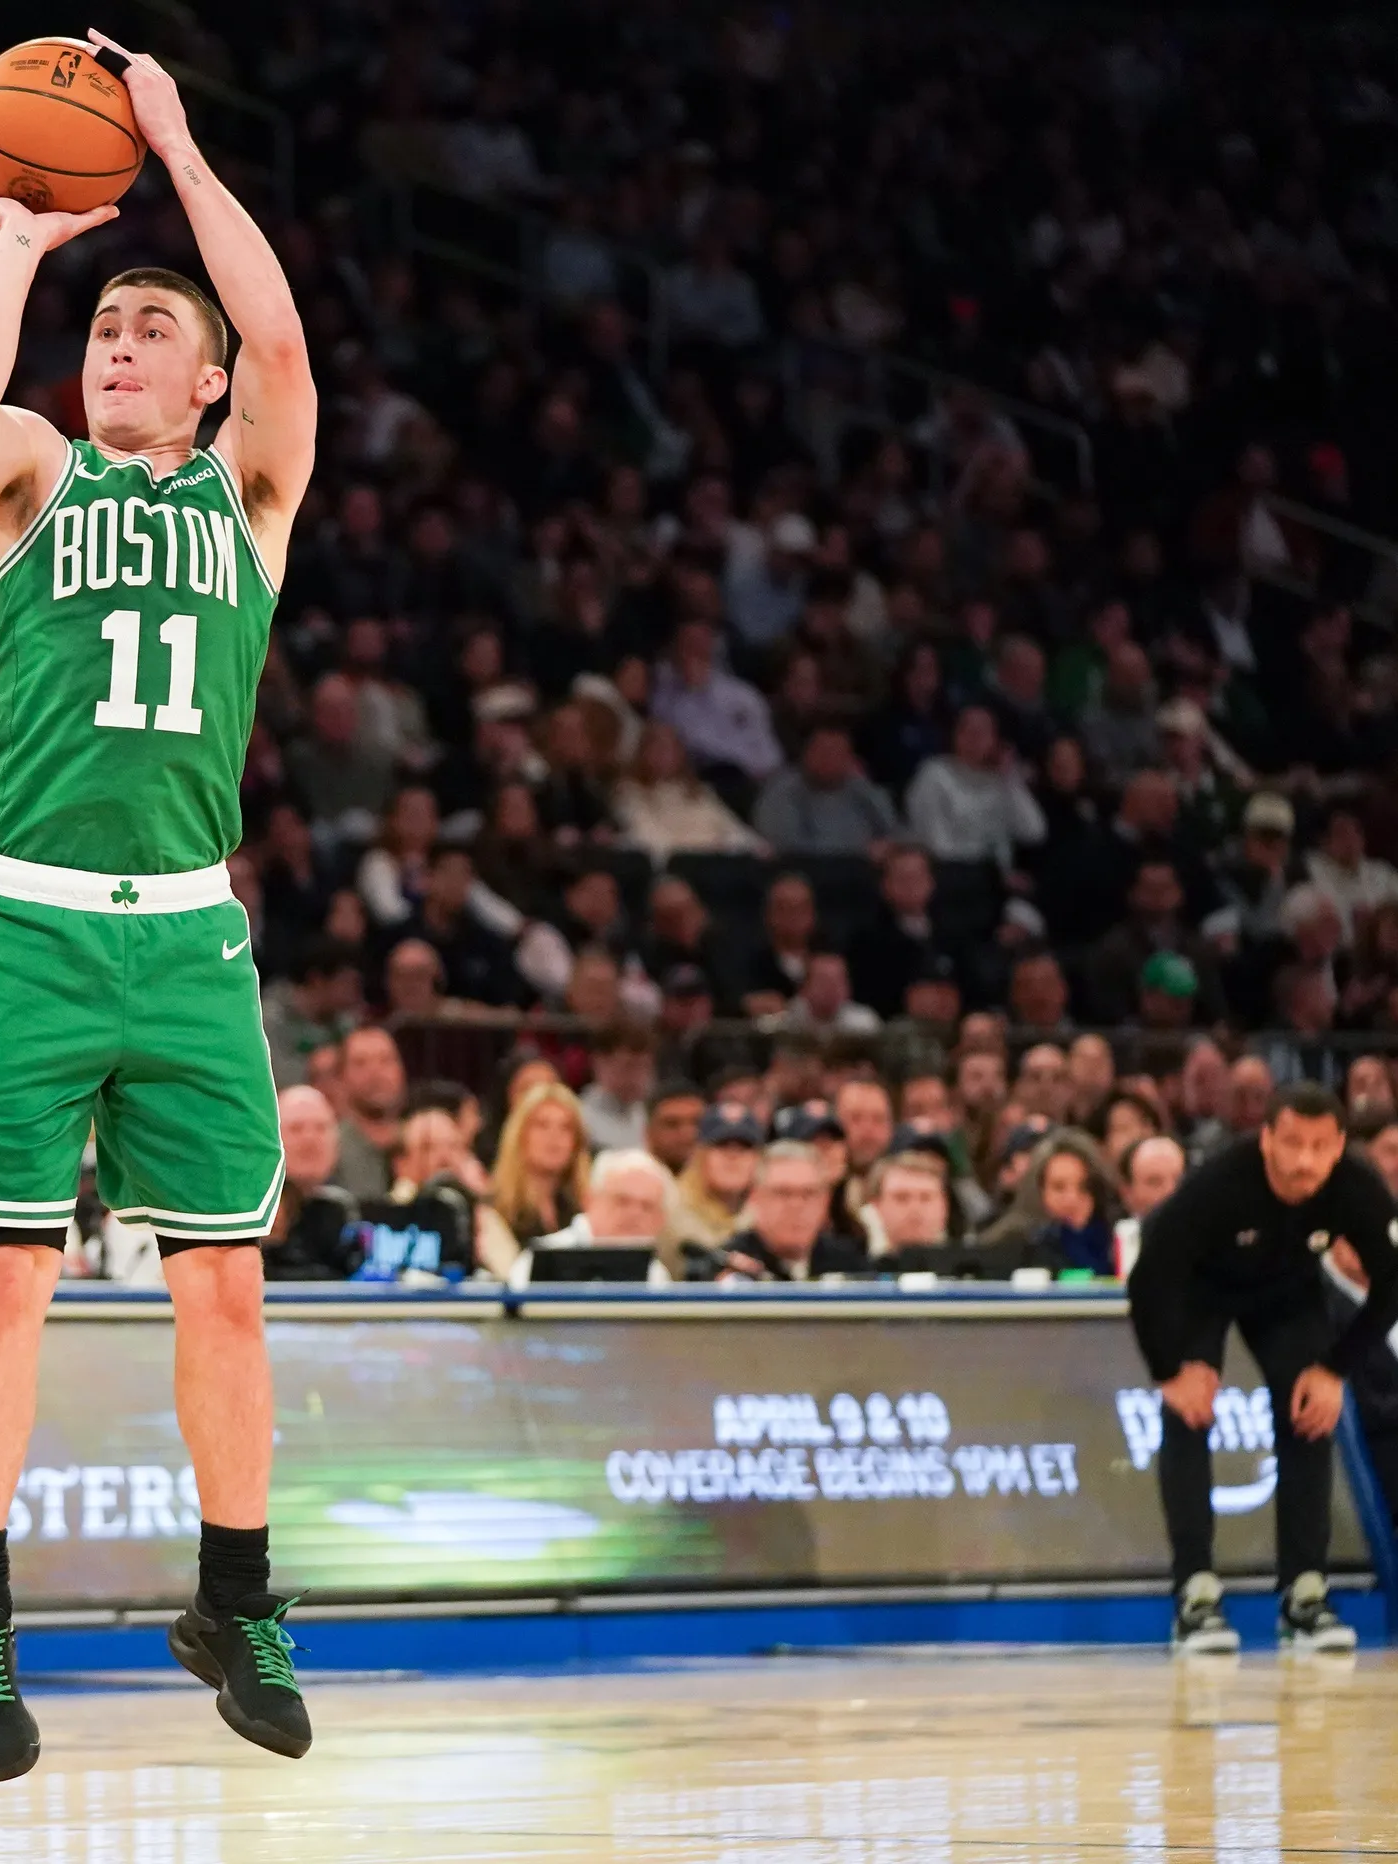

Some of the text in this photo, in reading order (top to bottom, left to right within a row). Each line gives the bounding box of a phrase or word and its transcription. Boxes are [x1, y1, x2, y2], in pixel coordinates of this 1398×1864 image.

[183, 165, 201, 185] 1998
[163, 467, 215, 494] Amica
[54, 496, 238, 608] BOSTON
[93, 610, 203, 734] 11
[713, 1394, 834, 1447] APRIL
[897, 1392, 950, 1445] 10
[606, 1449, 818, 1503] COVERAGE
[814, 1446, 955, 1499] BEGINS
[1030, 1443, 1079, 1496] ET
